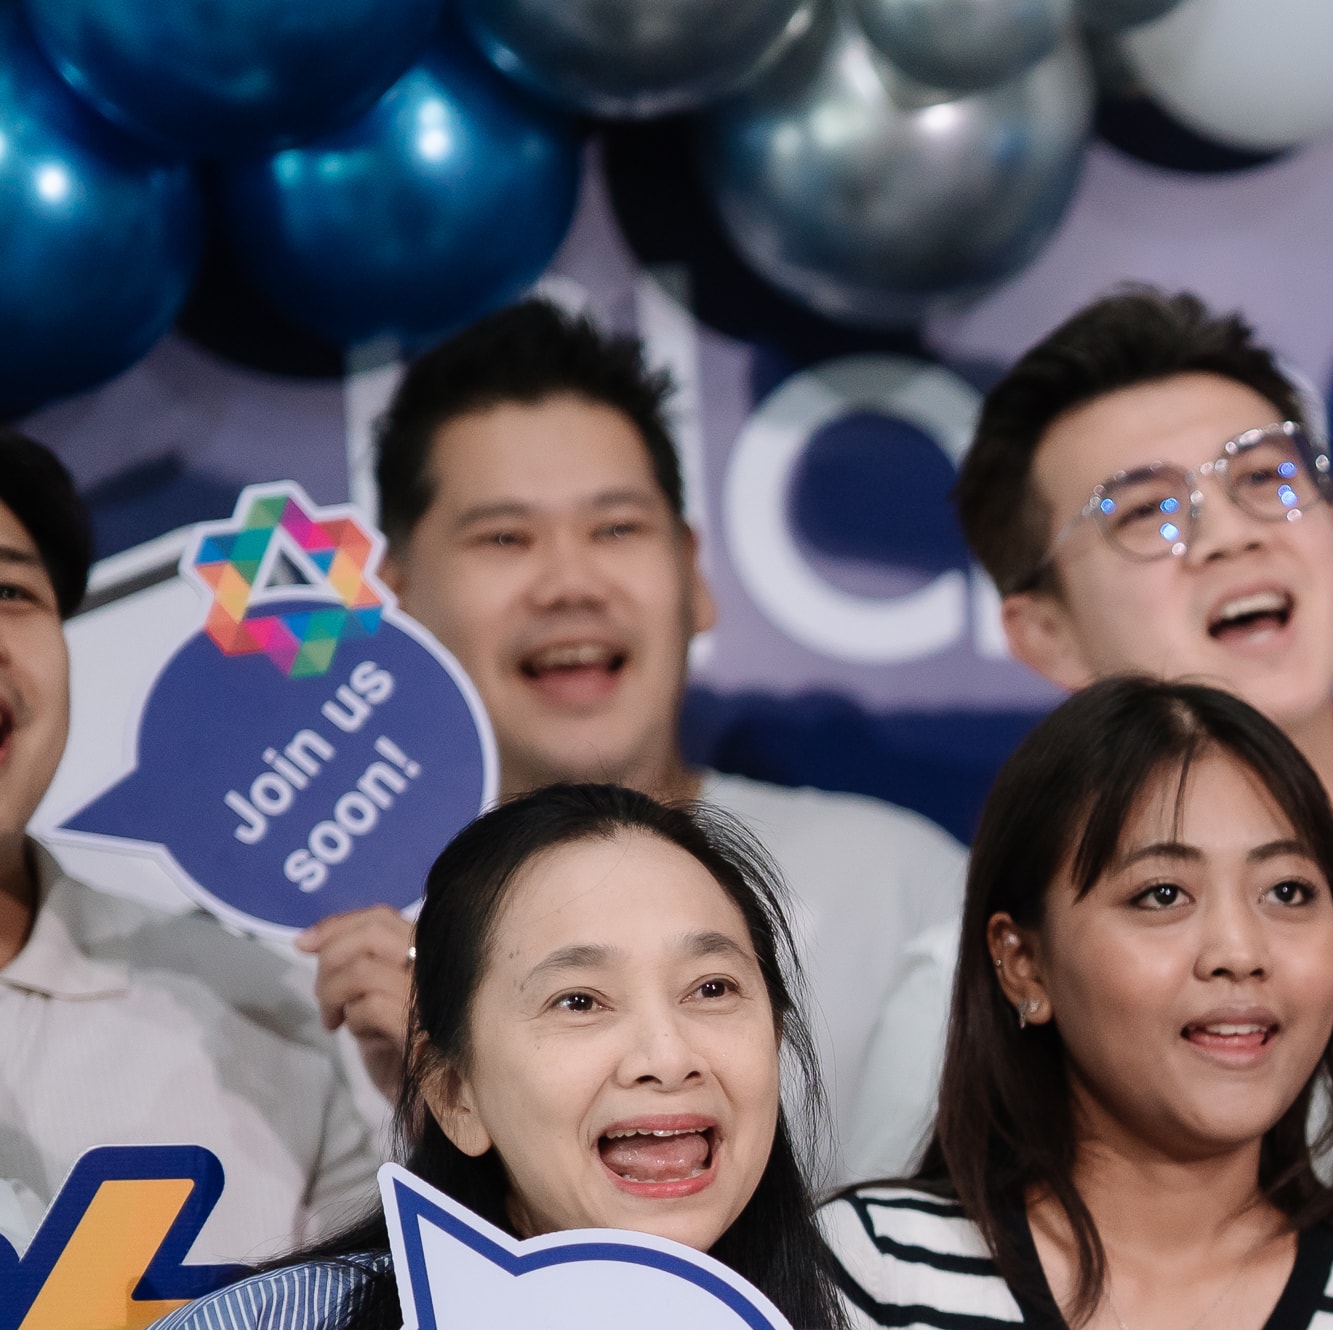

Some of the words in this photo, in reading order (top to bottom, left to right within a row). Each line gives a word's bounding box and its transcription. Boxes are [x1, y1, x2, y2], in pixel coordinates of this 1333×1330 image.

[224, 726, 335, 845] Join
[320, 660, 395, 734] us
[283, 734, 422, 893] soon!
